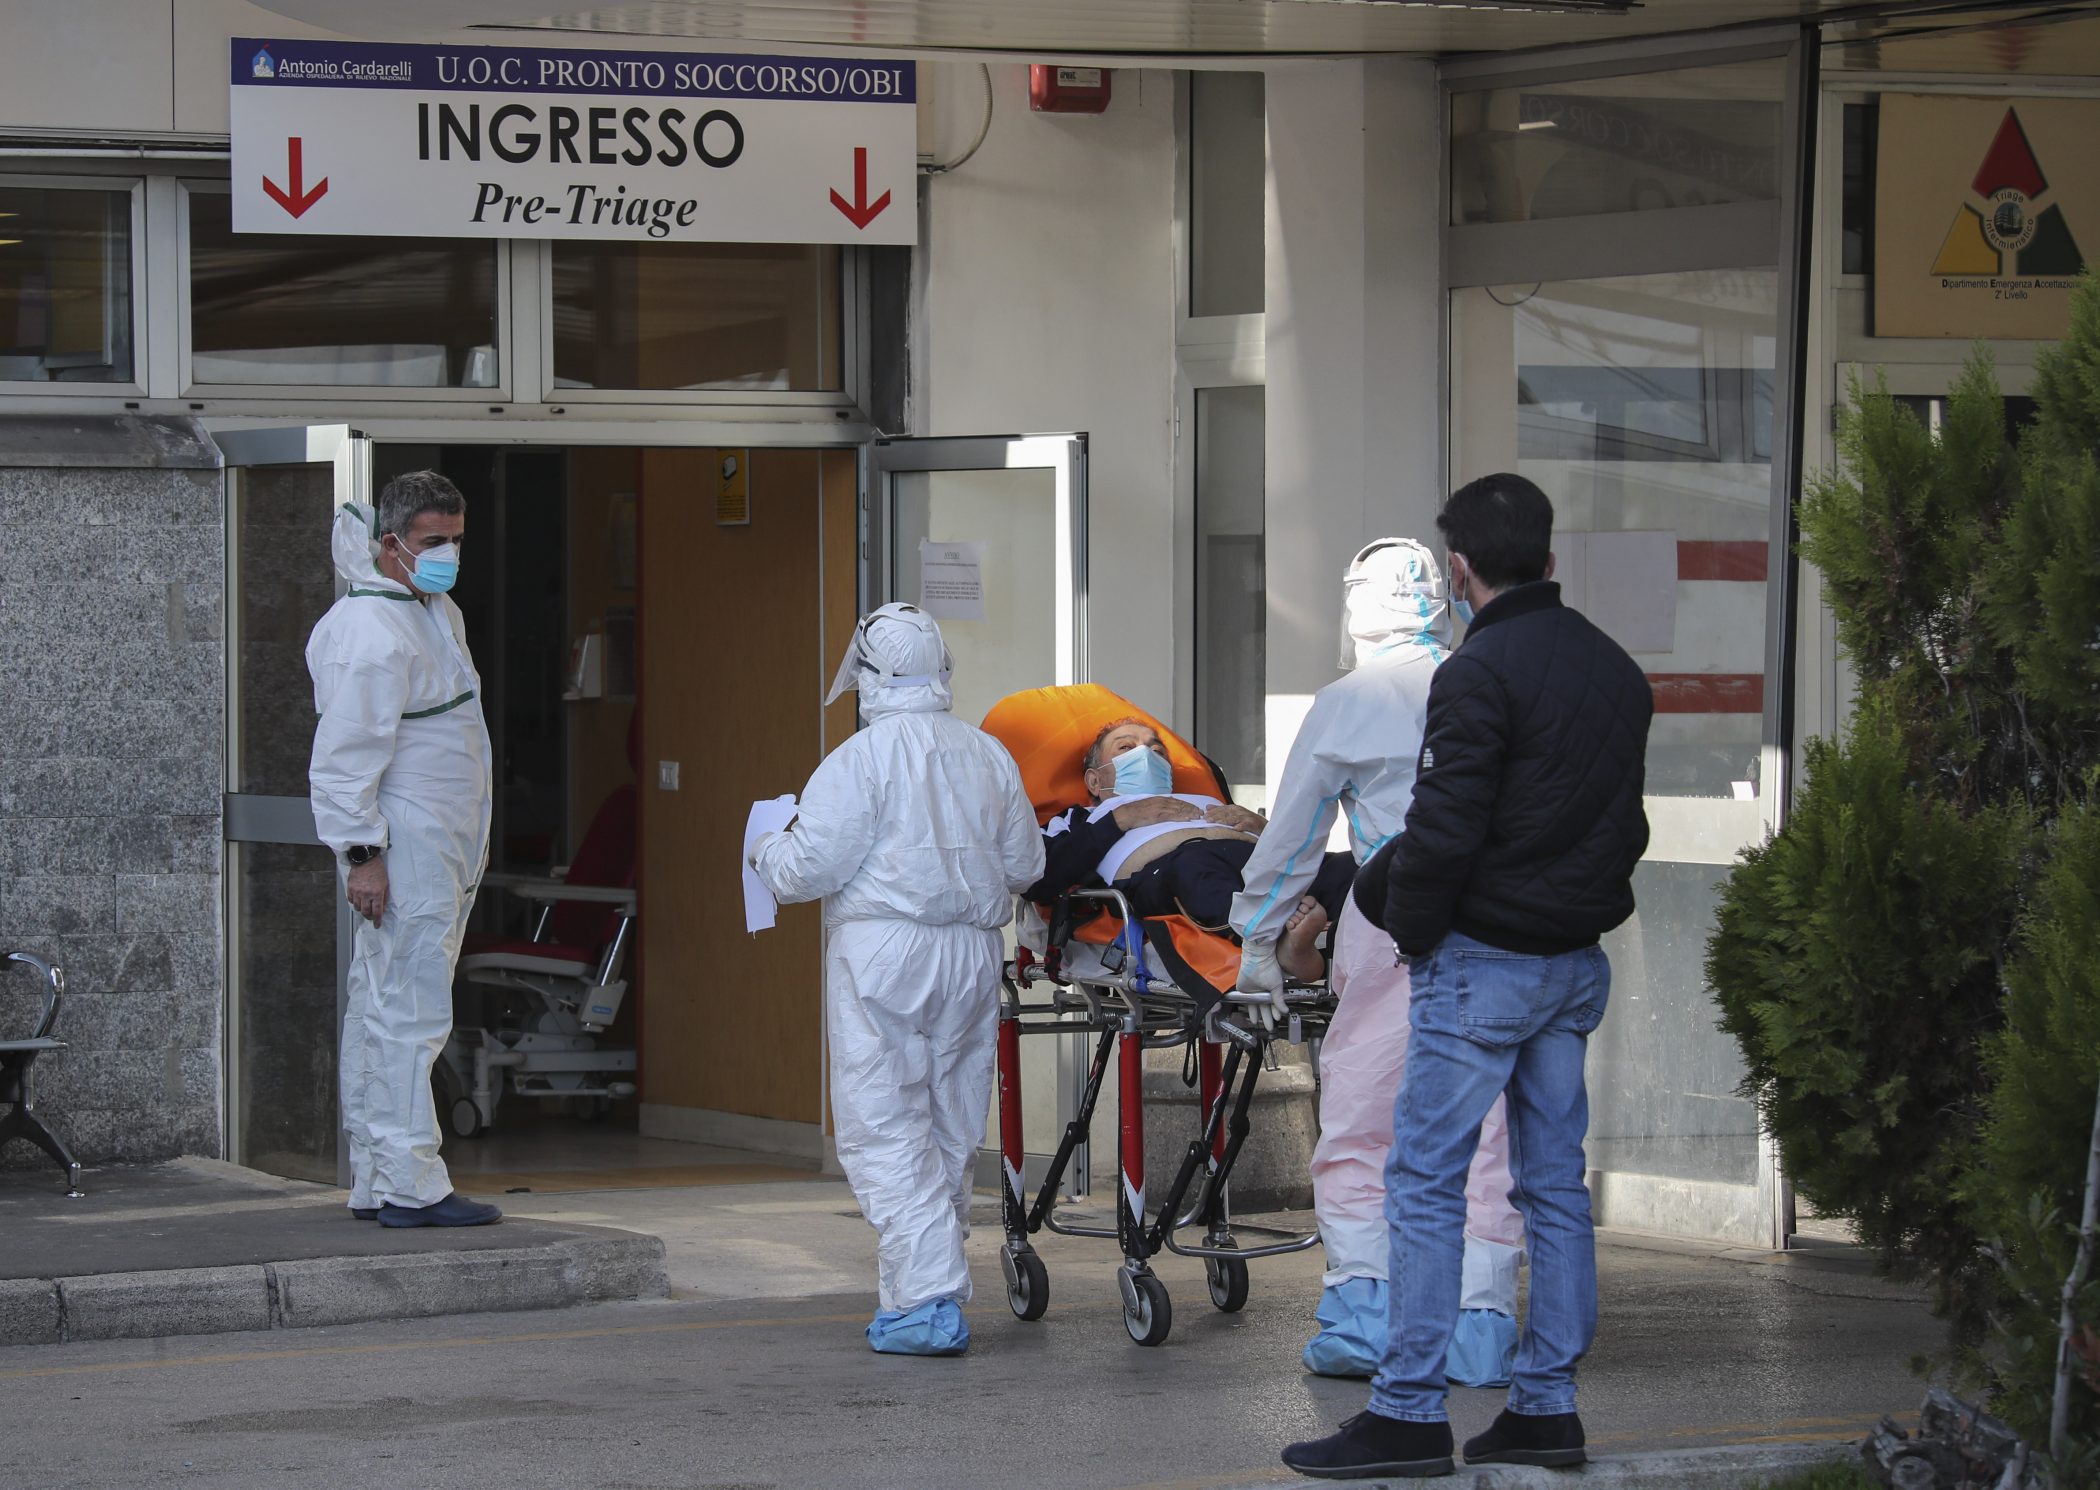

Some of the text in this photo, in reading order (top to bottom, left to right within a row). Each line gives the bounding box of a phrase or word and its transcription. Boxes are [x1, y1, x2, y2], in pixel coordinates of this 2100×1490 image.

[279, 59, 412, 76] Antonio Cardarelli
[437, 56, 902, 96] U.O.C. PRONTO SOCCORSO/OBI
[418, 102, 745, 169] INGRESSO
[1995, 190, 2024, 203] Triage
[470, 182, 698, 238] Pre-Triage
[1985, 218, 2034, 250] Infermieristico
[1941, 279, 1988, 289] Dipartimento
[1990, 279, 2033, 289] Emergenza
[2004, 290, 2028, 300] Livello
